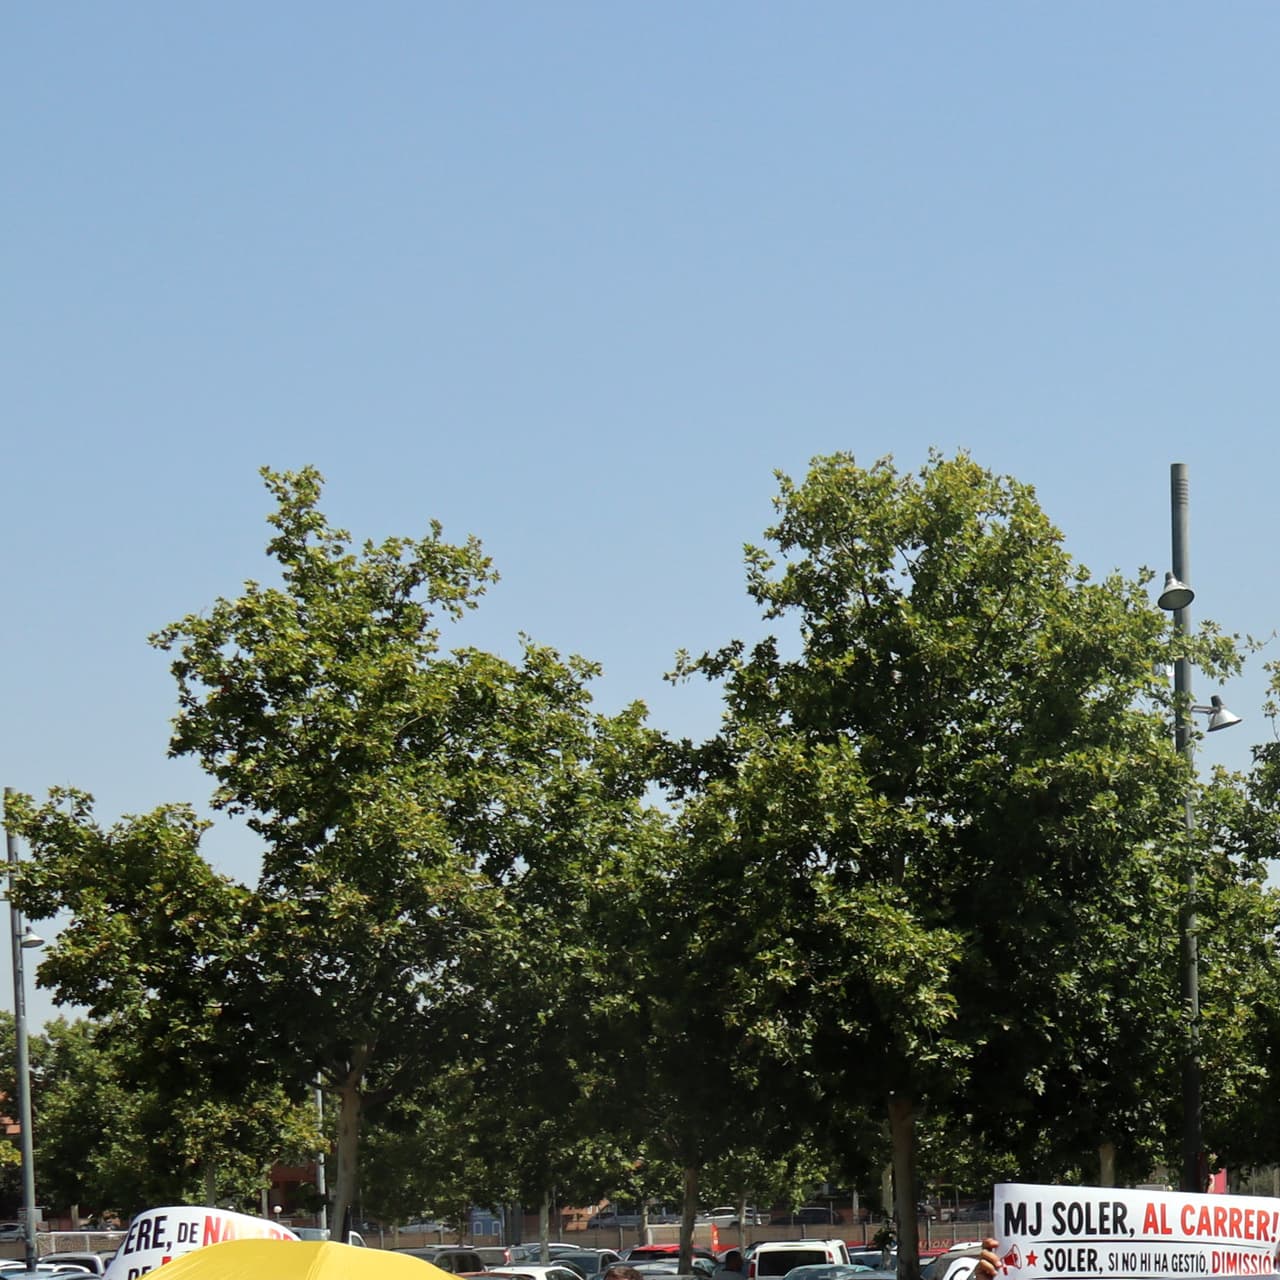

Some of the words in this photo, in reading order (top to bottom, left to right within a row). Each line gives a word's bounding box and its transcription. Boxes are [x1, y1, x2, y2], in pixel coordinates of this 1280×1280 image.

[1004, 1202, 1042, 1236] MJ
[1052, 1202, 1135, 1239] SOLER,
[1142, 1203, 1172, 1234] AL
[1180, 1204, 1279, 1242] CARRER!
[1044, 1248, 1102, 1273] SOLER,
[1109, 1253, 1120, 1271] SI
[1123, 1252, 1138, 1271] NO
[1140, 1252, 1151, 1272] HI
[1154, 1253, 1168, 1272] HA
[1172, 1249, 1208, 1275] GESTIÓ,
